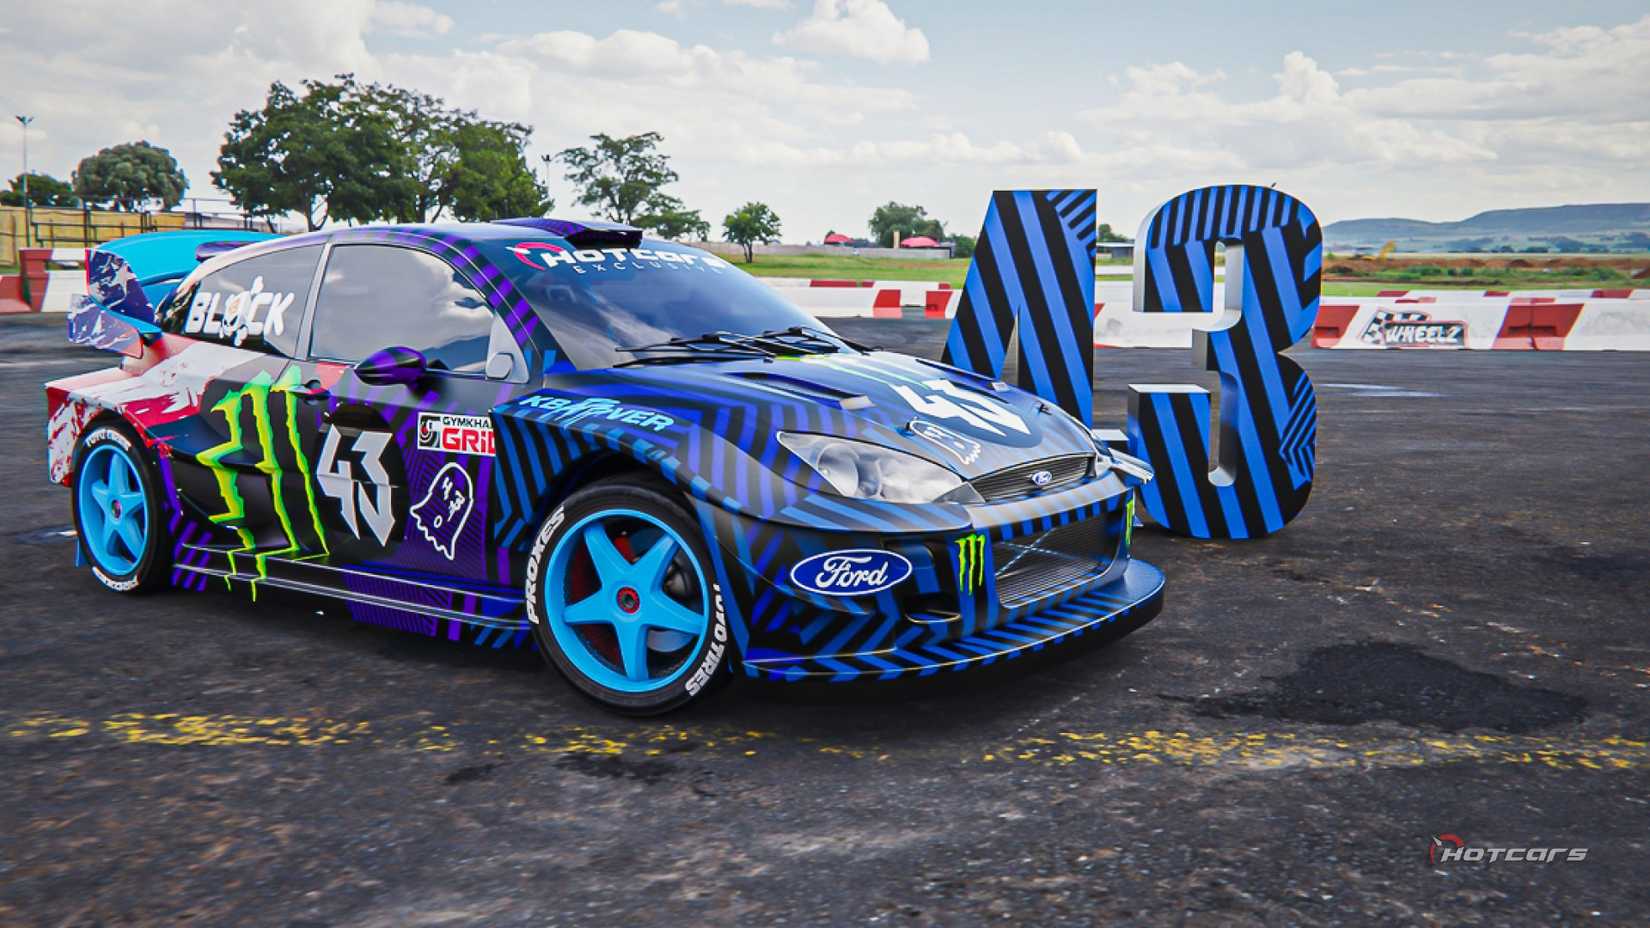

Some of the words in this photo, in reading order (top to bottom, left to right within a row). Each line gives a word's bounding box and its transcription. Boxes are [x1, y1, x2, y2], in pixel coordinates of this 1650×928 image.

[316, 423, 396, 547] 43
[525, 505, 565, 625] PROXES
[815, 555, 889, 588] Ford
[684, 643, 726, 697] TIRES
